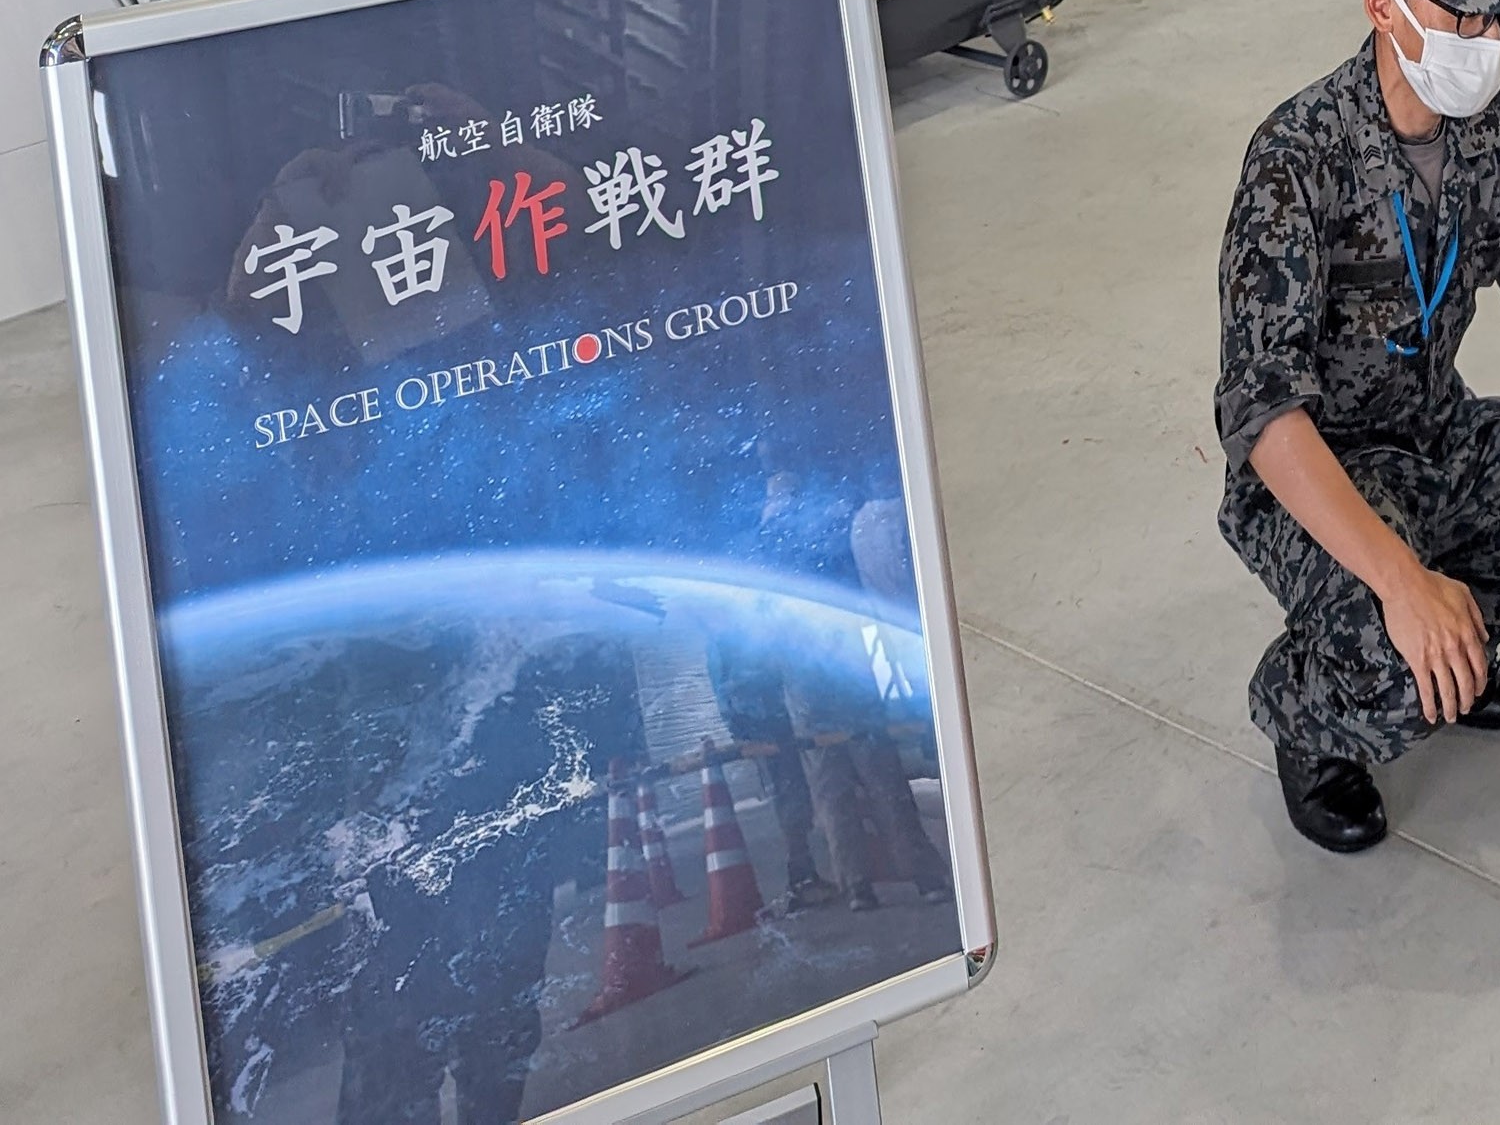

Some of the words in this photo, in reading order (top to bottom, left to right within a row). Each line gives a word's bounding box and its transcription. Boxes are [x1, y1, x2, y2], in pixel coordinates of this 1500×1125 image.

[416, 93, 603, 162] 航空自衛隊
[244, 118, 780, 335] 宇宙作戦群
[254, 387, 382, 448] SPACE
[396, 318, 654, 411] OPERATIONS
[665, 282, 799, 341] GROUP
